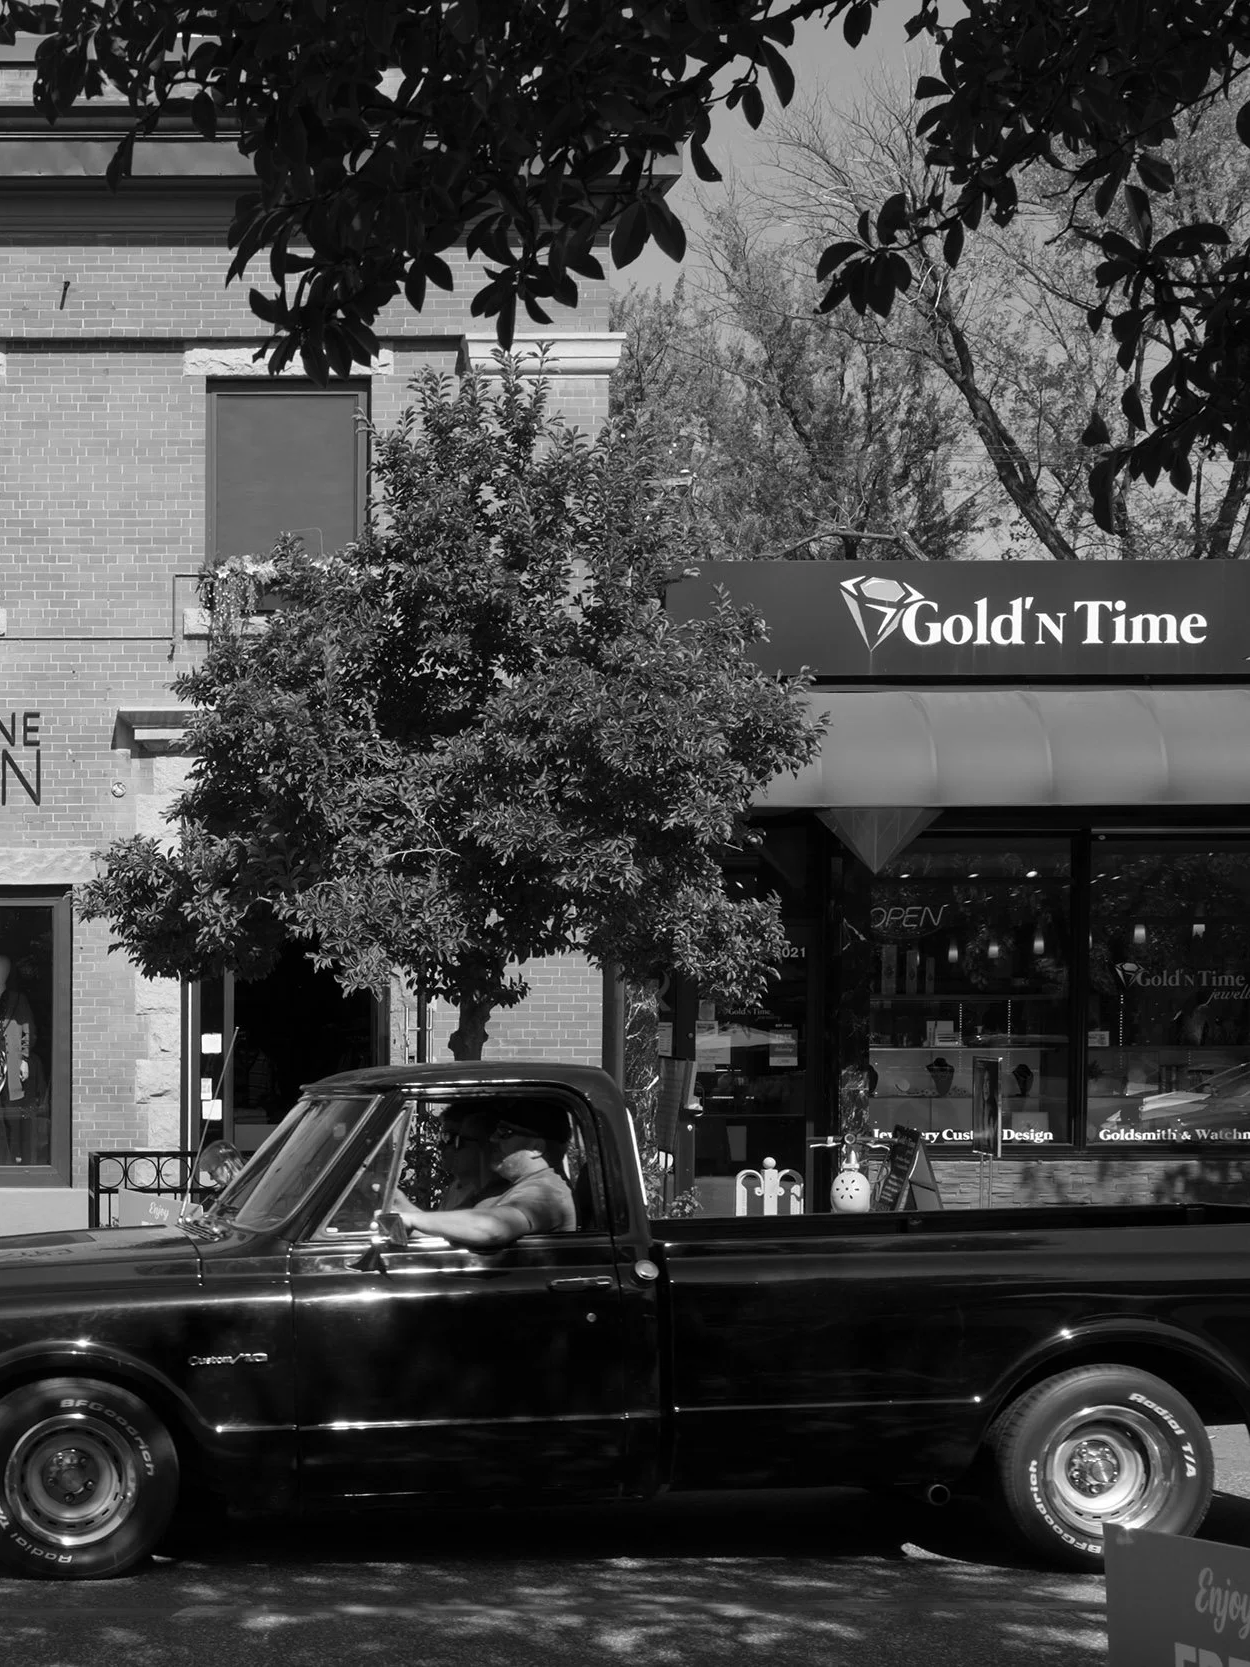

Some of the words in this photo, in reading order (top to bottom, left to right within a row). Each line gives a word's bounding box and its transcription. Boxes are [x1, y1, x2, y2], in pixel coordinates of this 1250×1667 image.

[1074, 600, 1208, 645] Time
[870, 906, 944, 928] OPEN
[1198, 970, 1246, 987] Time
[1197, 984, 1250, 1010] jewell
[942, 1128, 974, 1141] Cust
[1002, 1128, 1054, 1143] Design
[1099, 1128, 1177, 1141] Goldsmith
[1181, 1130, 1192, 1140] &
[148, 1201, 170, 1221] Enjoy
[59, 1398, 155, 1477] BFGoodrich
[1128, 1392, 1187, 1436] Radial
[1181, 1442, 1197, 1478] T/A
[1028, 1460, 1102, 1555] BFGoodrich
[10, 1532, 73, 1564] Radial
[1195, 1567, 1250, 1640] Enjoy
